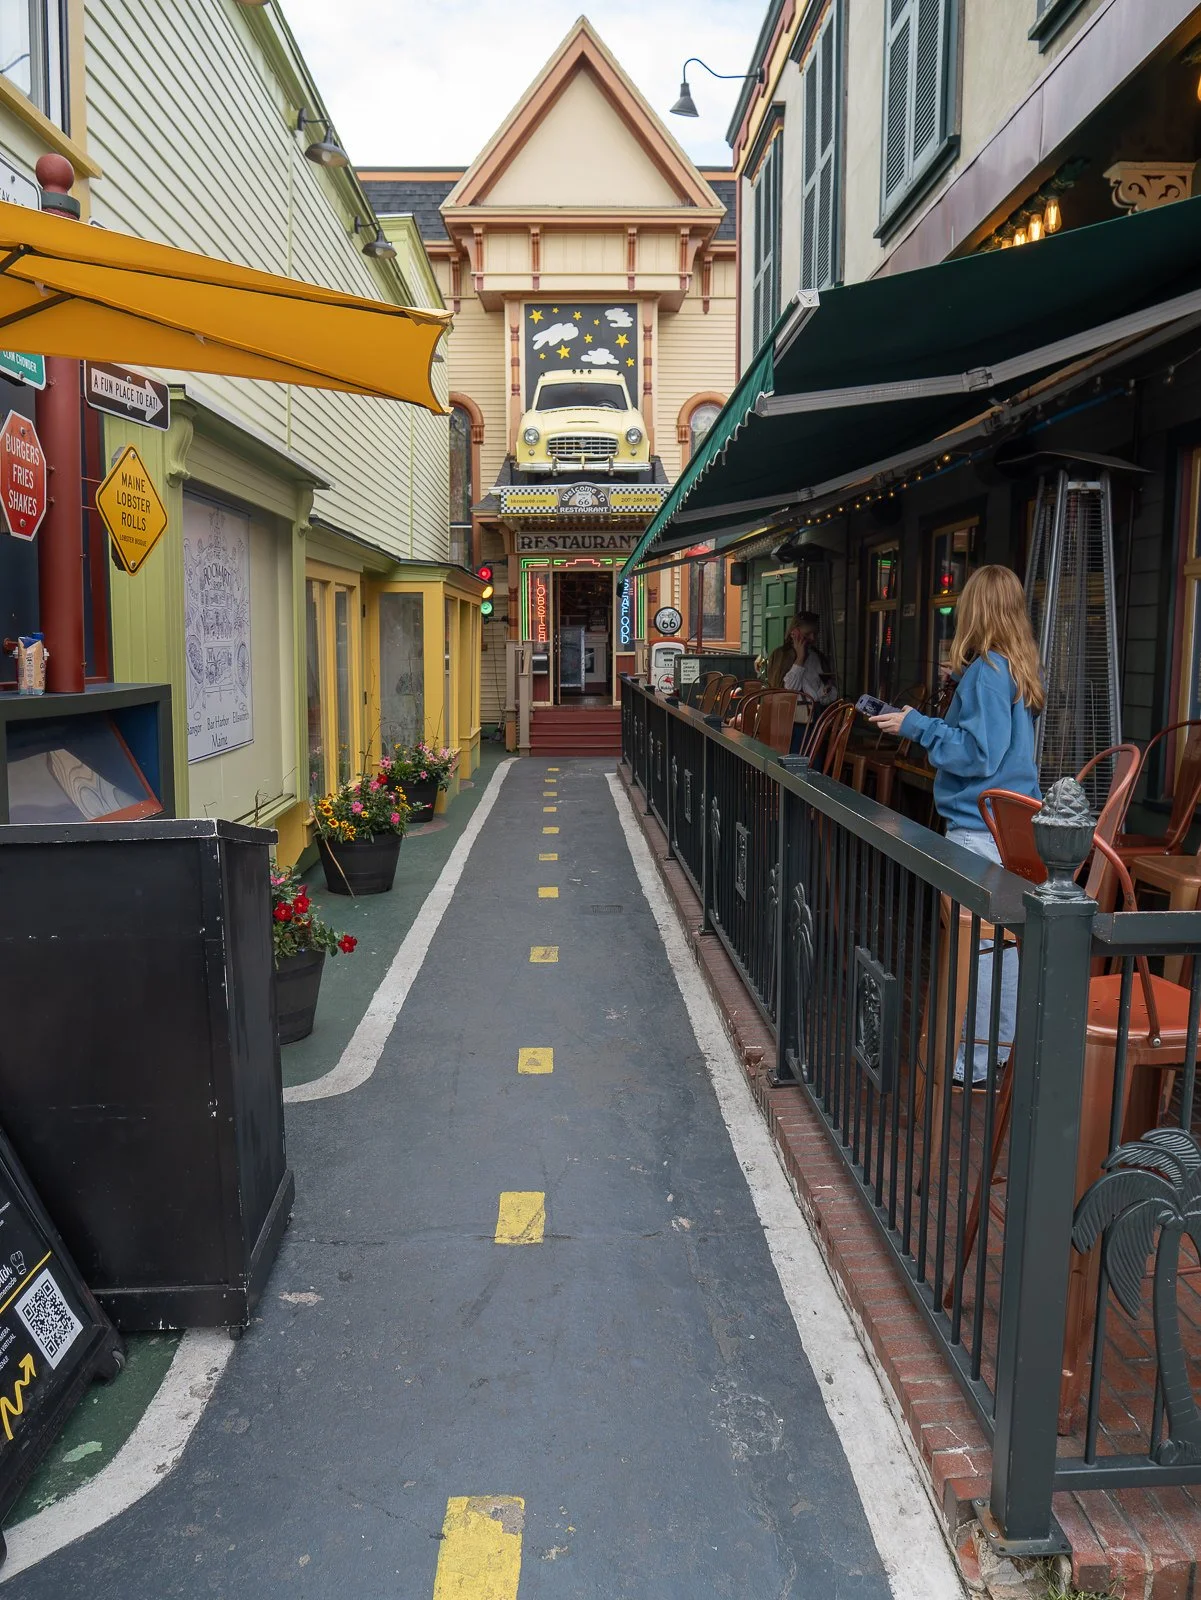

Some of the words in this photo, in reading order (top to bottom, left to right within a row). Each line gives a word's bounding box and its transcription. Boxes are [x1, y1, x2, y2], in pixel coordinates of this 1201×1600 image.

[94, 374, 99, 389] A
[101, 377, 113, 394] FUN
[116, 382, 134, 401] PLACE
[136, 391, 144, 405] TO
[146, 394, 158, 410] EAT!
[5, 432, 40, 466] BURGERS
[12, 463, 34, 489] FRIES
[121, 472, 146, 494] MAINE
[8, 489, 37, 517] SHAKES
[116, 490, 151, 514] LOBSTER
[561, 485, 597, 501] Welcome
[597, 491, 605, 502] To
[578, 498, 590, 506] 66
[121, 511, 146, 532] ROLLS
[520, 535, 642, 549] RESTAURANT
[662, 618, 676, 629] 66
